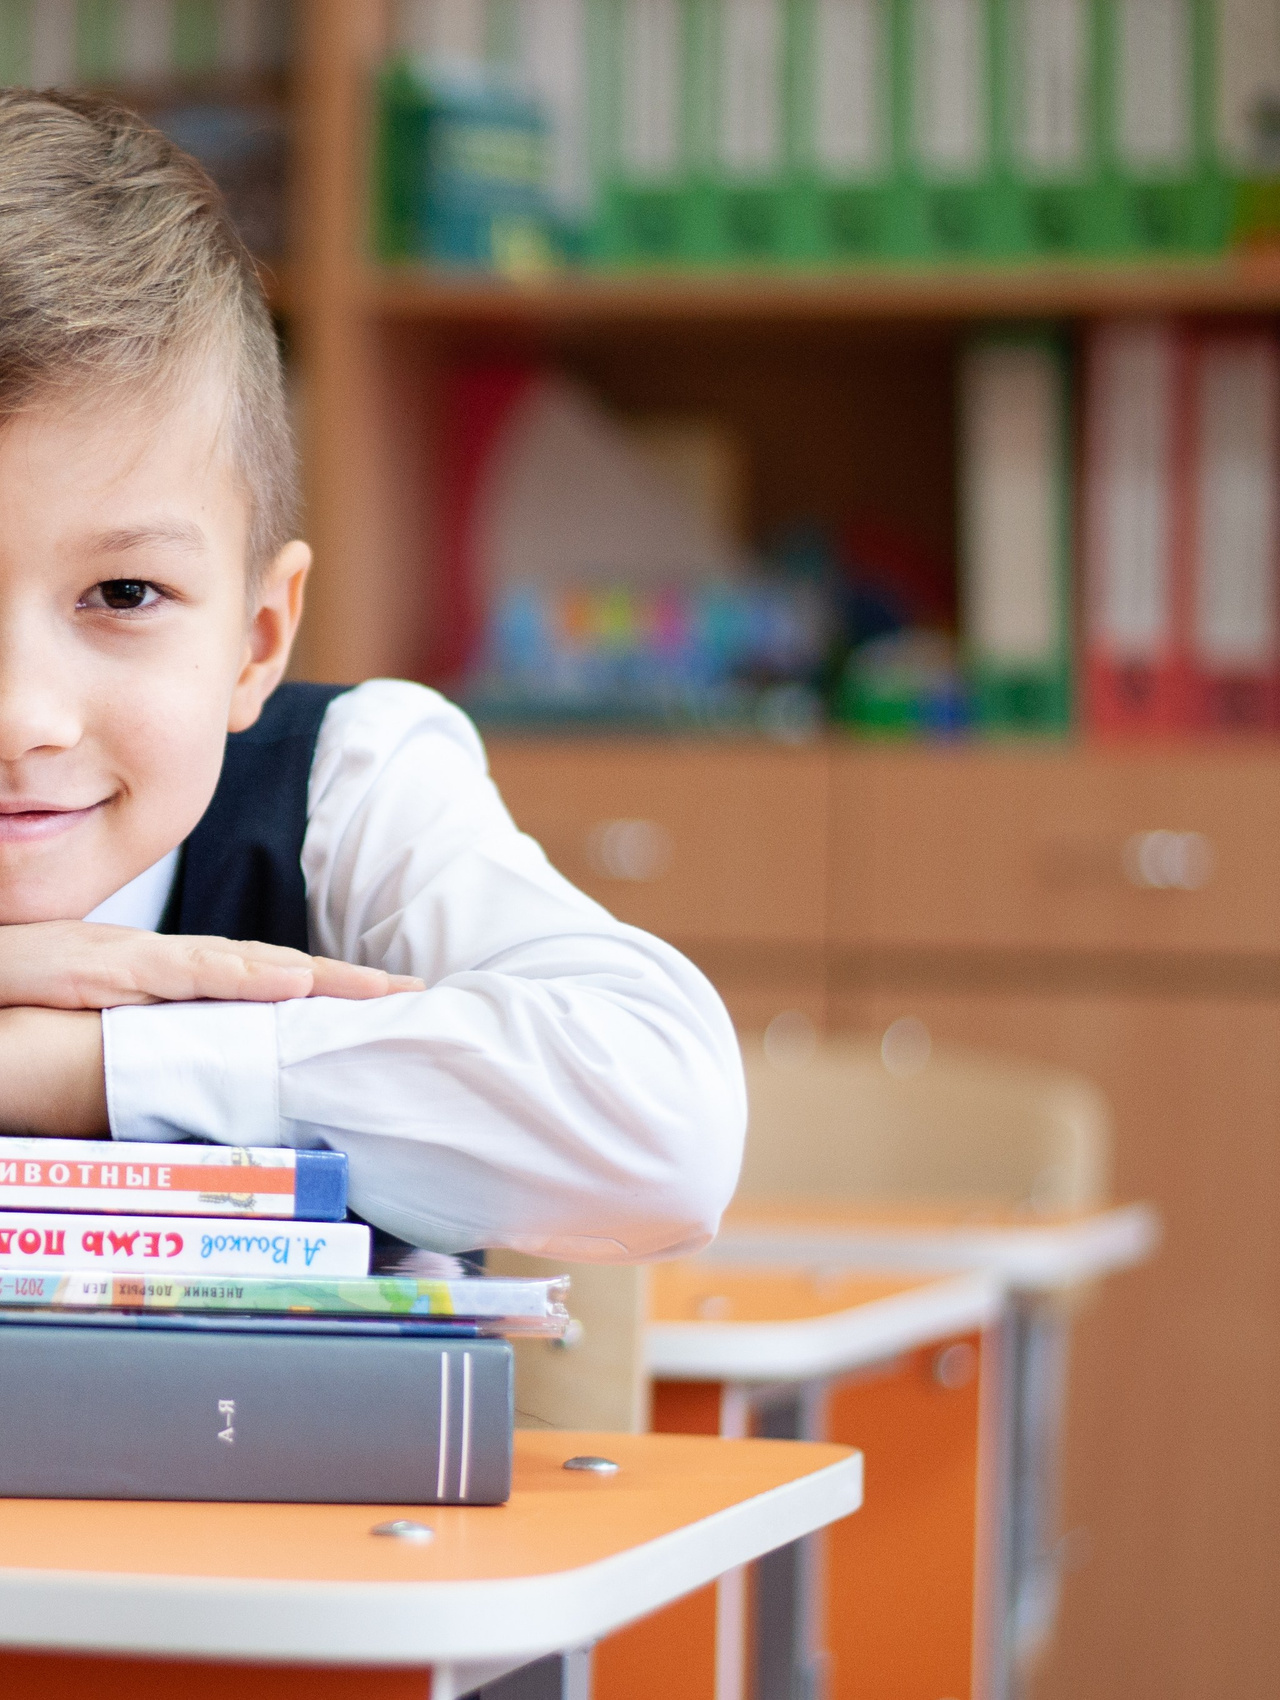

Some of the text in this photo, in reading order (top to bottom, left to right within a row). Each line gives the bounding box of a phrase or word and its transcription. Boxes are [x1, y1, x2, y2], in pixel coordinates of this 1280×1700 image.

[81, 1230, 184, 1258] СЕМЬ
[201, 1233, 291, 1264] Волков
[83, 1282, 245, 1299] ДНЕВНИК ДОБРЫХ ДЕЛ
